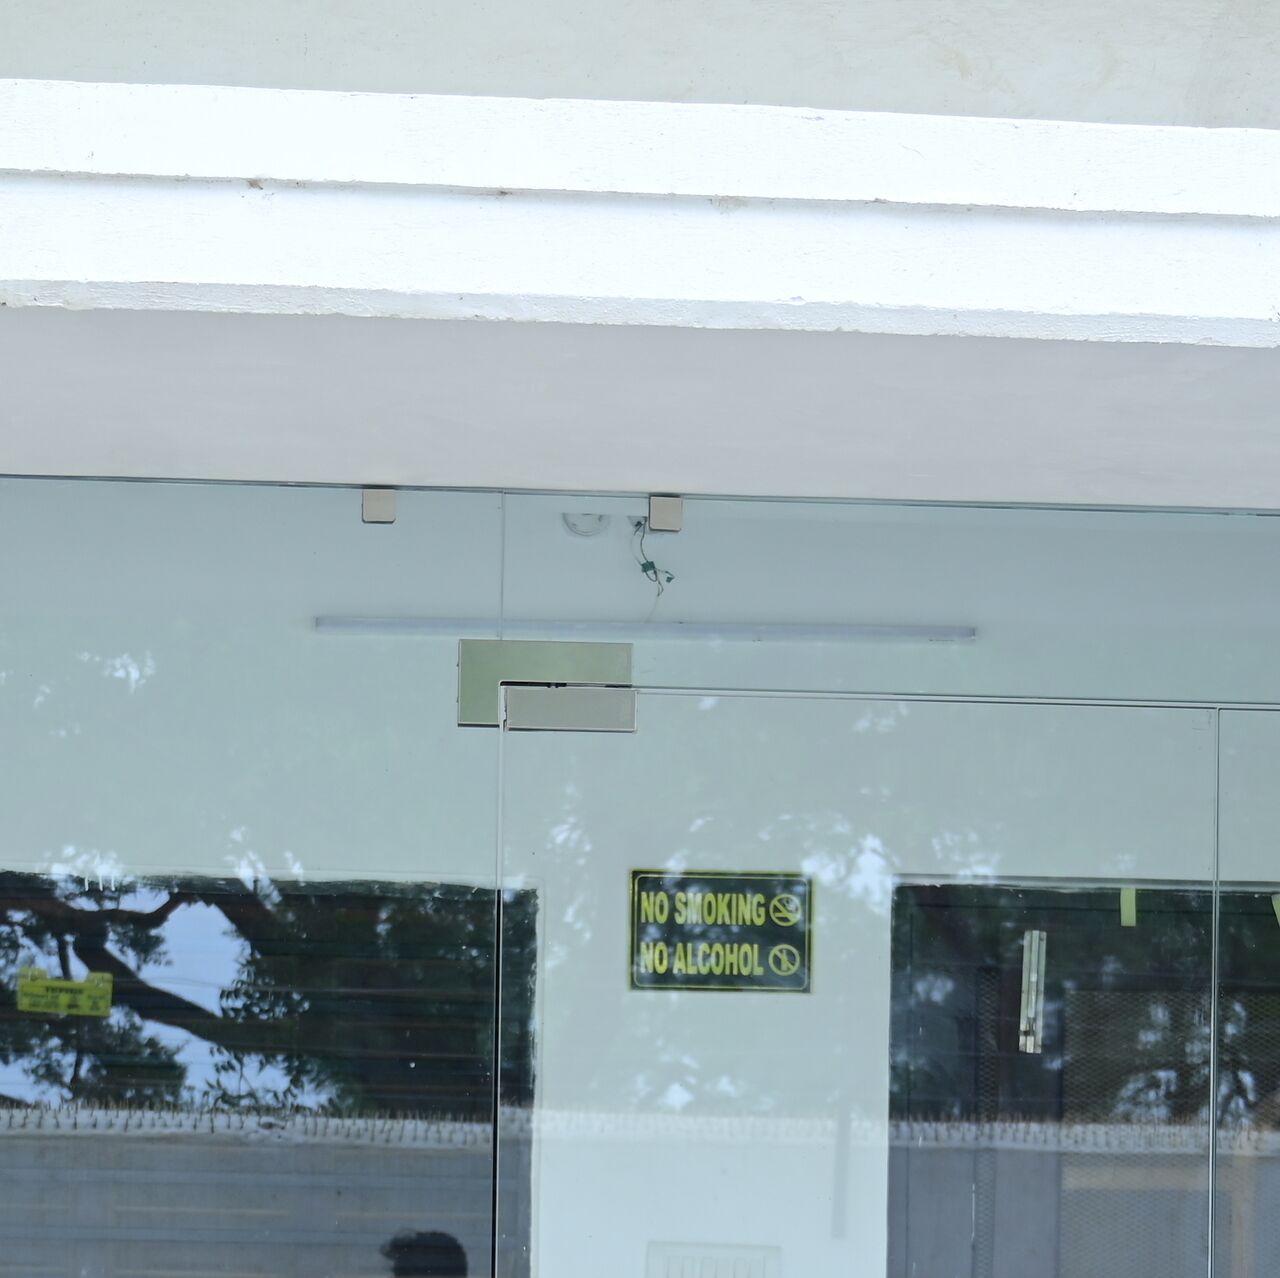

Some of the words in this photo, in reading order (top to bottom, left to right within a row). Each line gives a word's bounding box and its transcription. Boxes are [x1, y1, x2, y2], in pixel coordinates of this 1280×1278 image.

[641, 892, 669, 924] NO
[674, 892, 766, 926] SMOKING
[640, 942, 668, 974] NO
[673, 943, 764, 976] ALCOHOL
